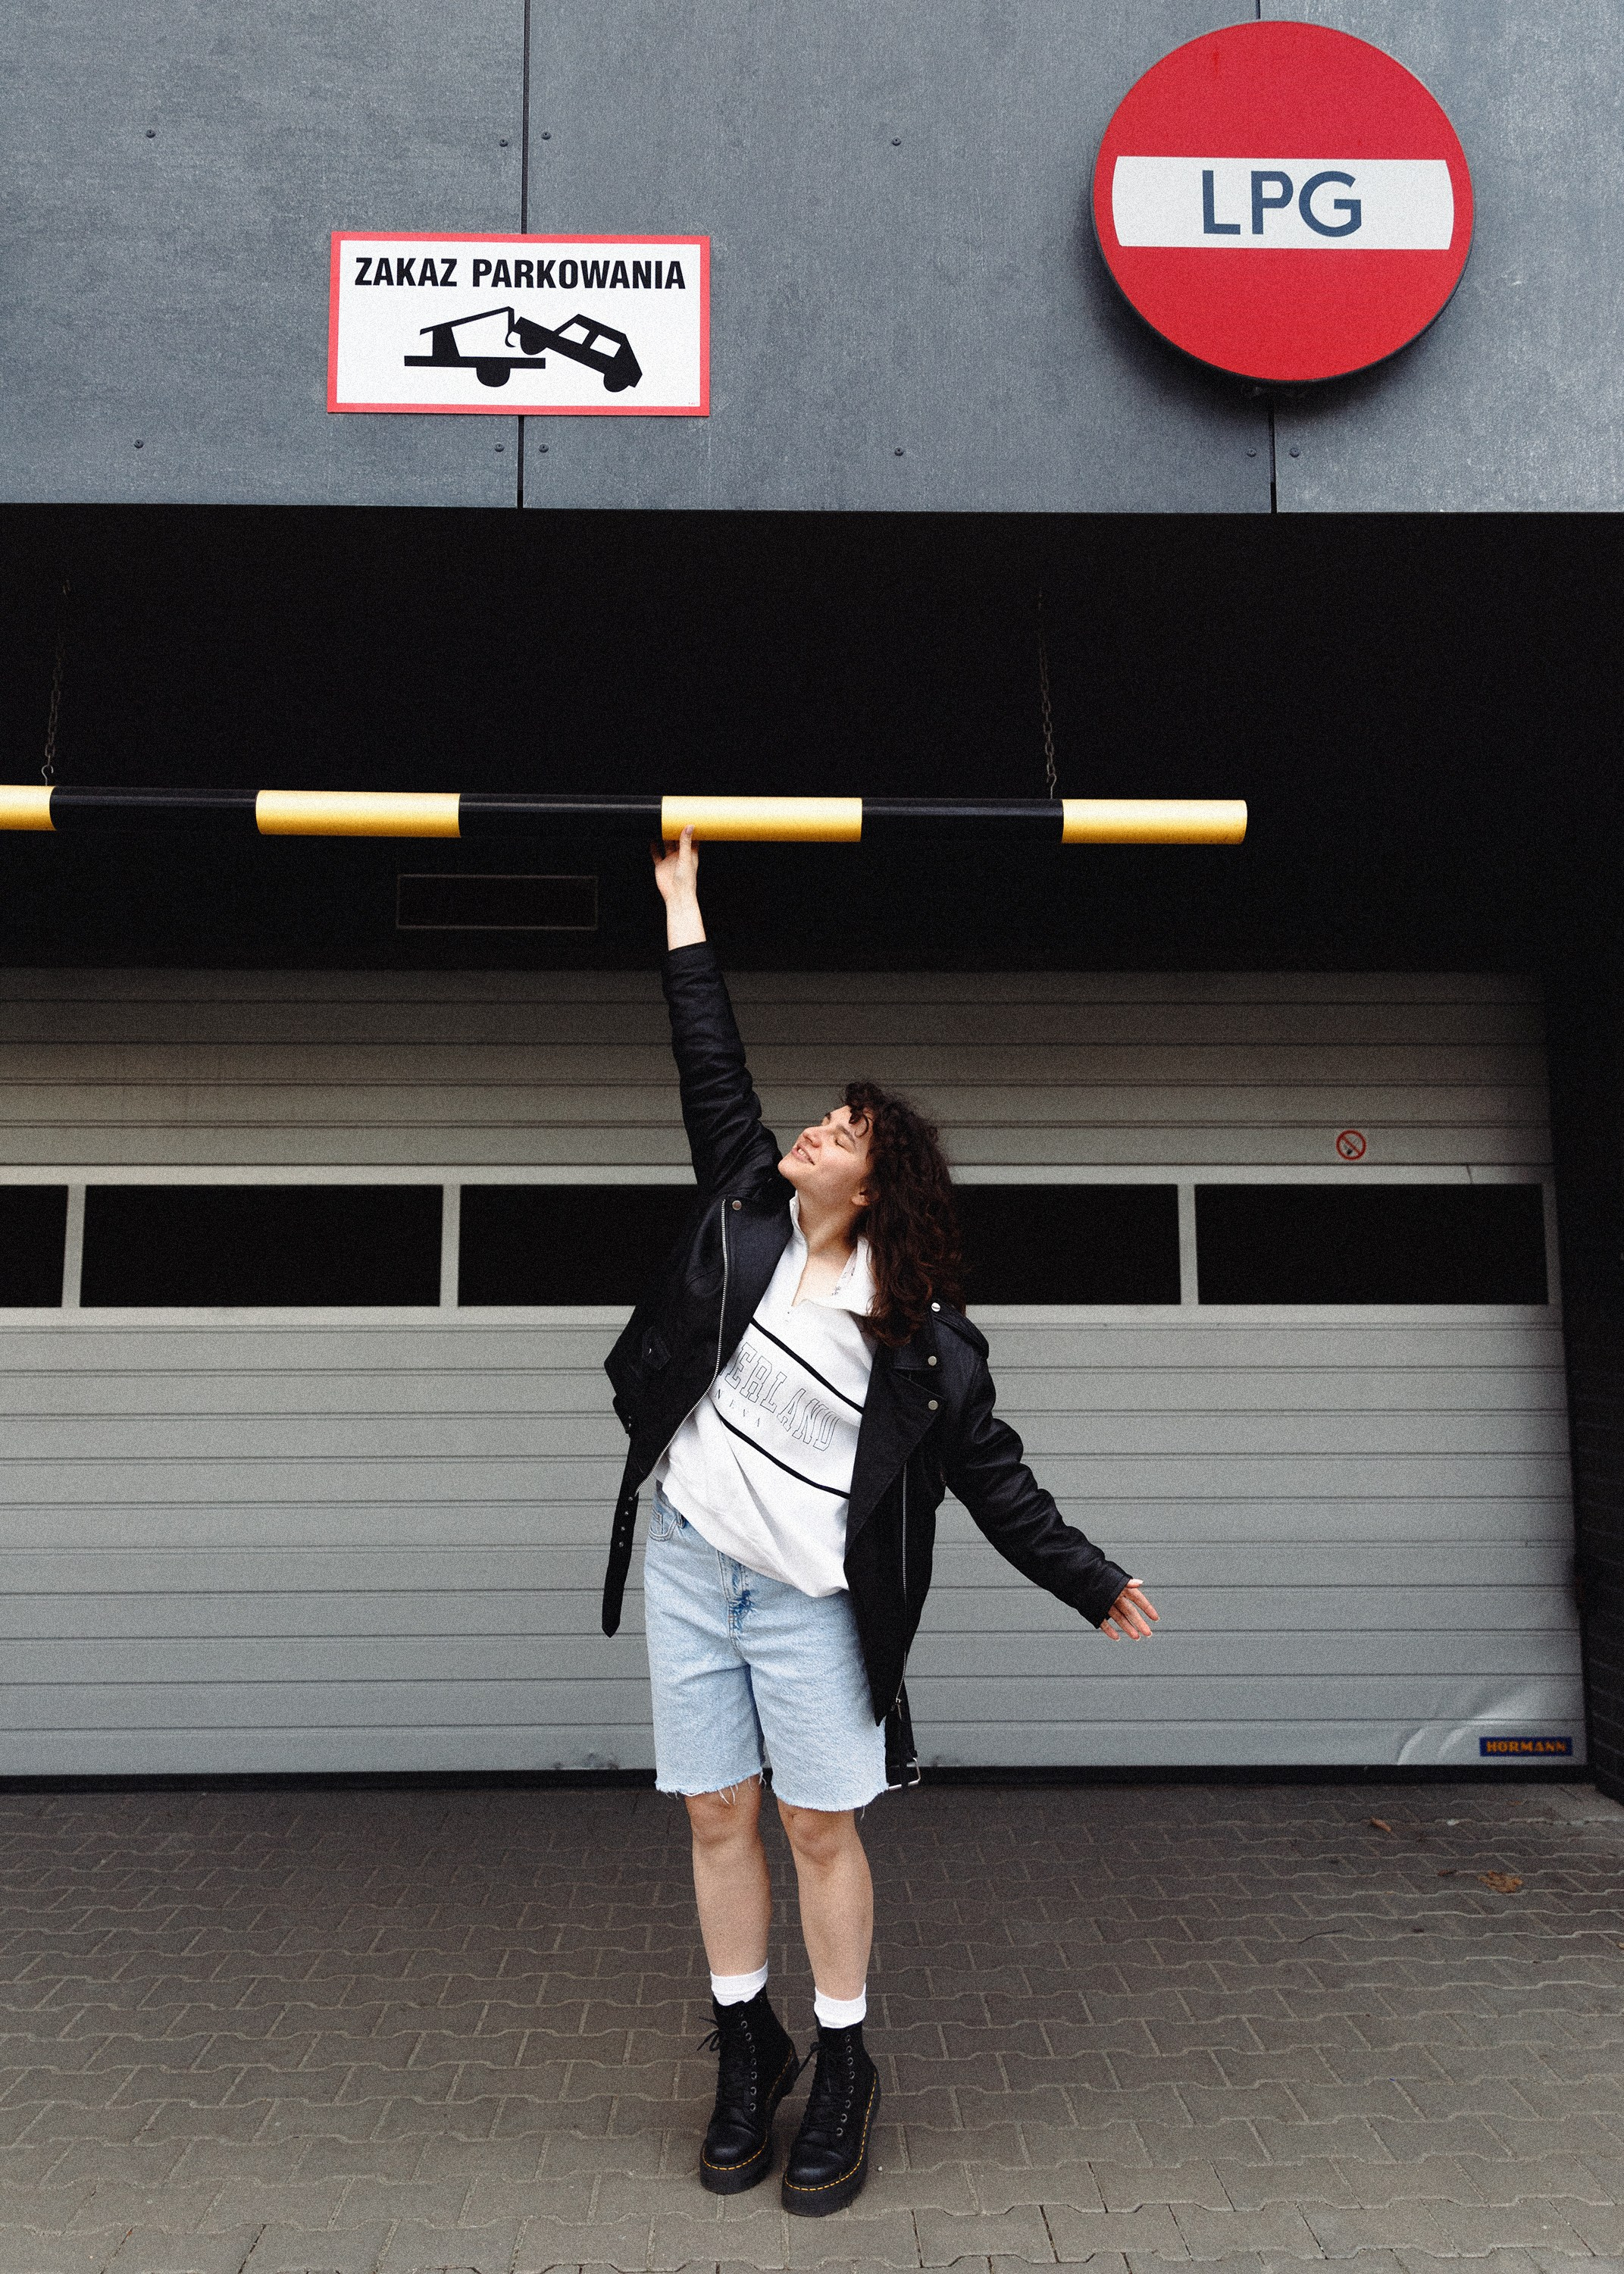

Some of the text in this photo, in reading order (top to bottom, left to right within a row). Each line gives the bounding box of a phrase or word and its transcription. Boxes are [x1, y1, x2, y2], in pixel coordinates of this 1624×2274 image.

[1202, 170, 1363, 238] LPG
[355, 257, 686, 290] ZAKAZ PARKOWANIA
[719, 1342, 840, 1452] ERLAND
